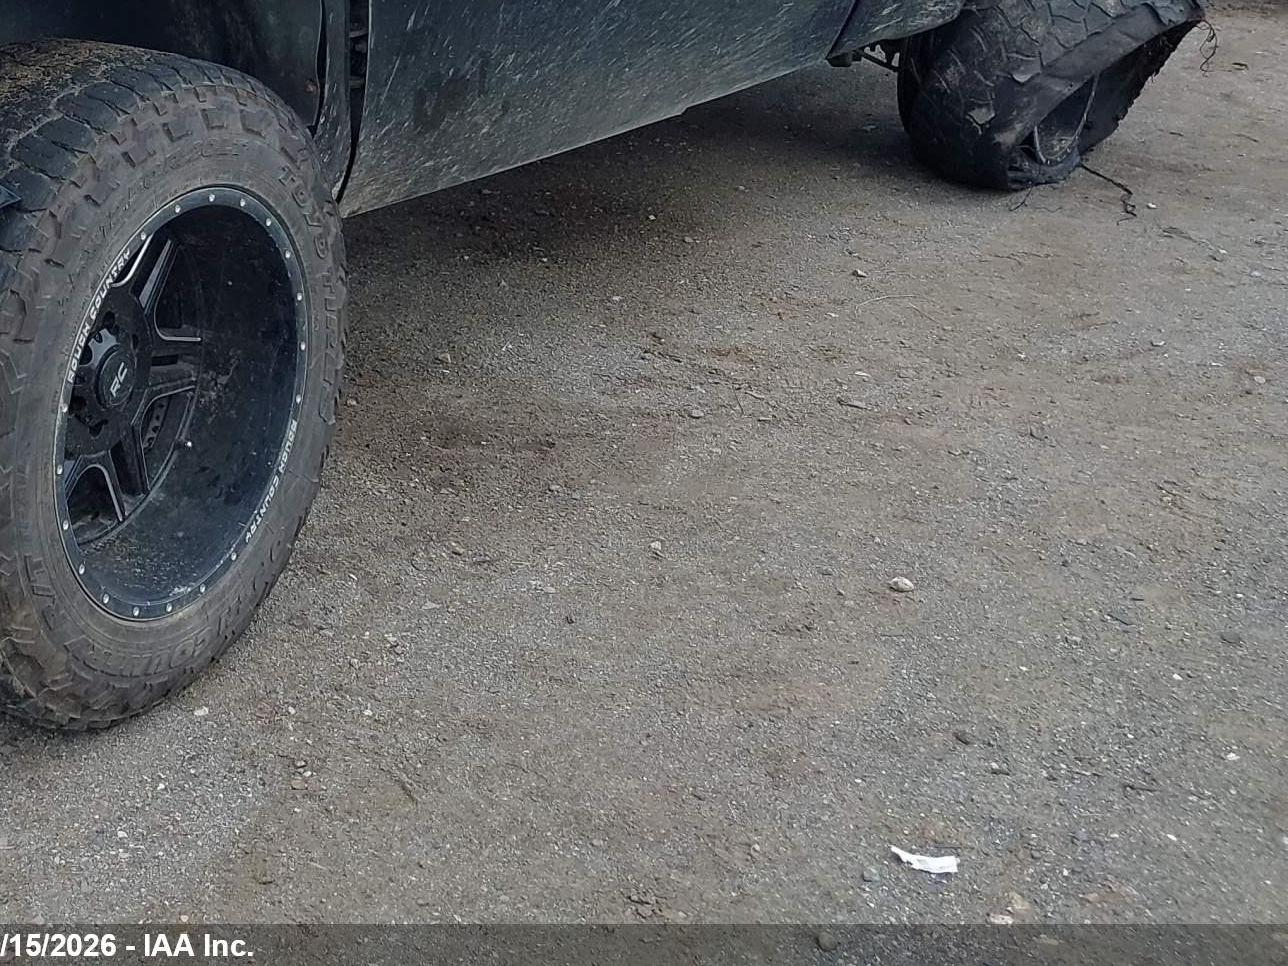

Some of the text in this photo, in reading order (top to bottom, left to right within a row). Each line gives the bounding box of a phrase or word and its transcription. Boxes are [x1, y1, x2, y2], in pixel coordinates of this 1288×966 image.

[67, 247, 131, 383] ROUGH COUNTRY
[110, 361, 128, 398] RC
[245, 475, 279, 543] COUNTRY
